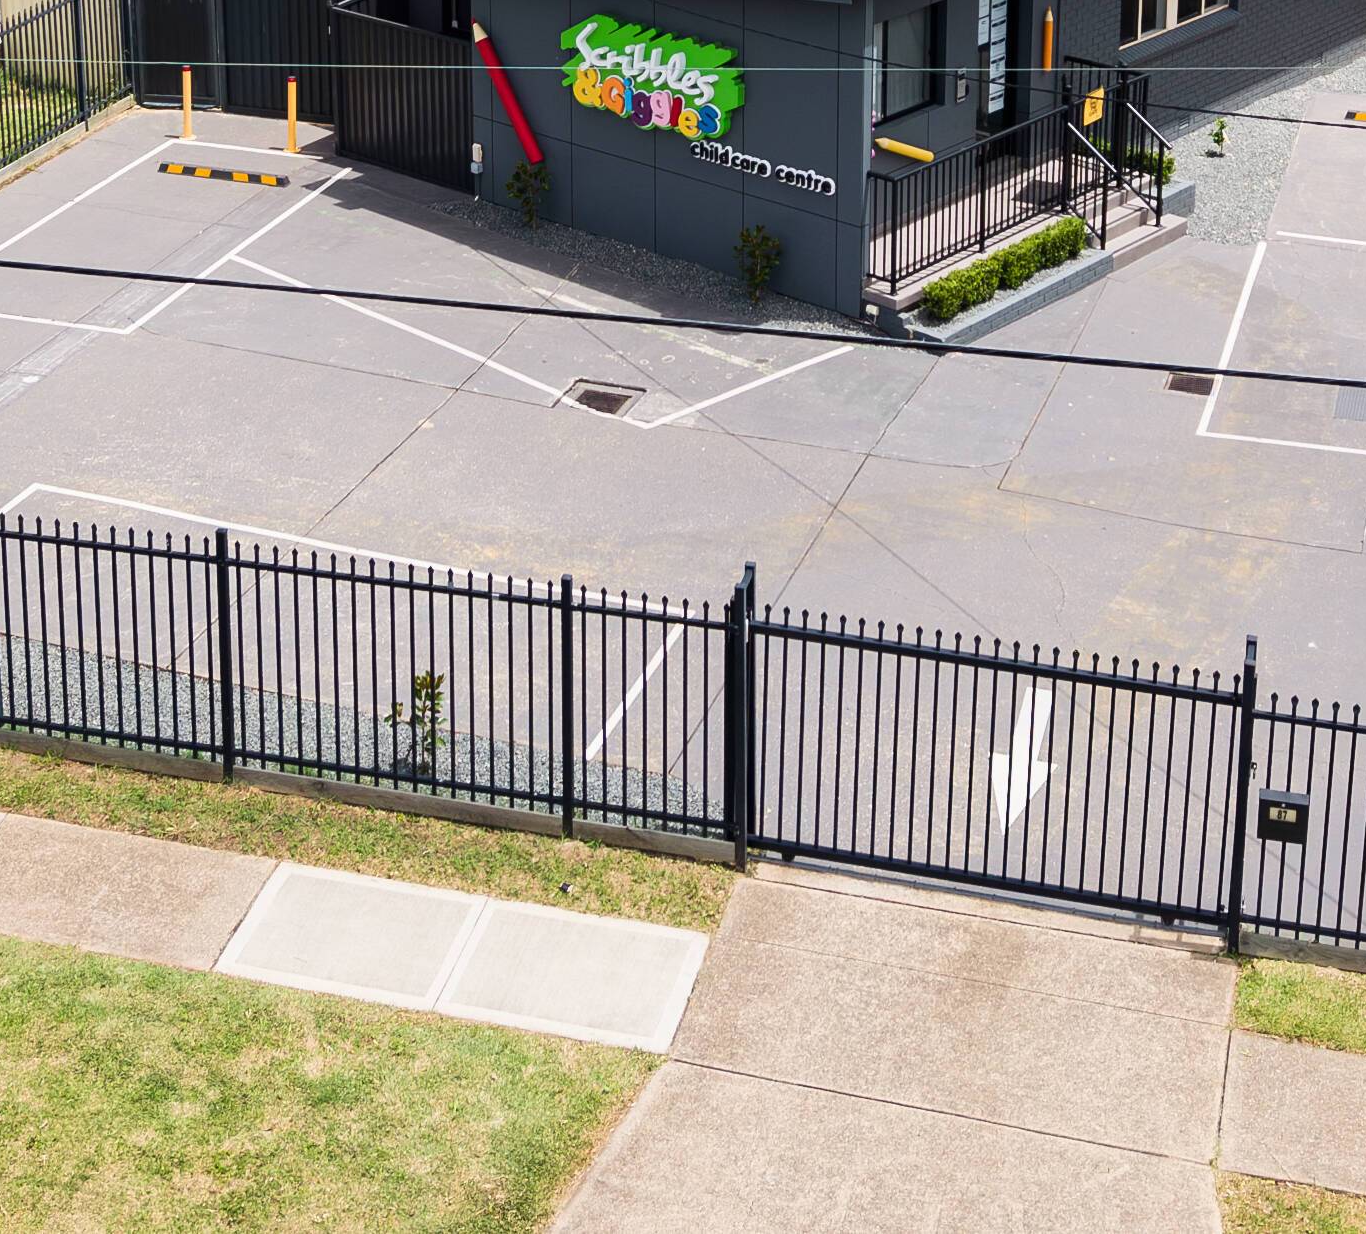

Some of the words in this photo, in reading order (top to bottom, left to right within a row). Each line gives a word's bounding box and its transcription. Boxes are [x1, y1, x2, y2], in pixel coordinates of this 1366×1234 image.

[576, 22, 718, 105] Scribbles
[775, 165, 836, 196] centre
[1276, 809, 1288, 820] 87
